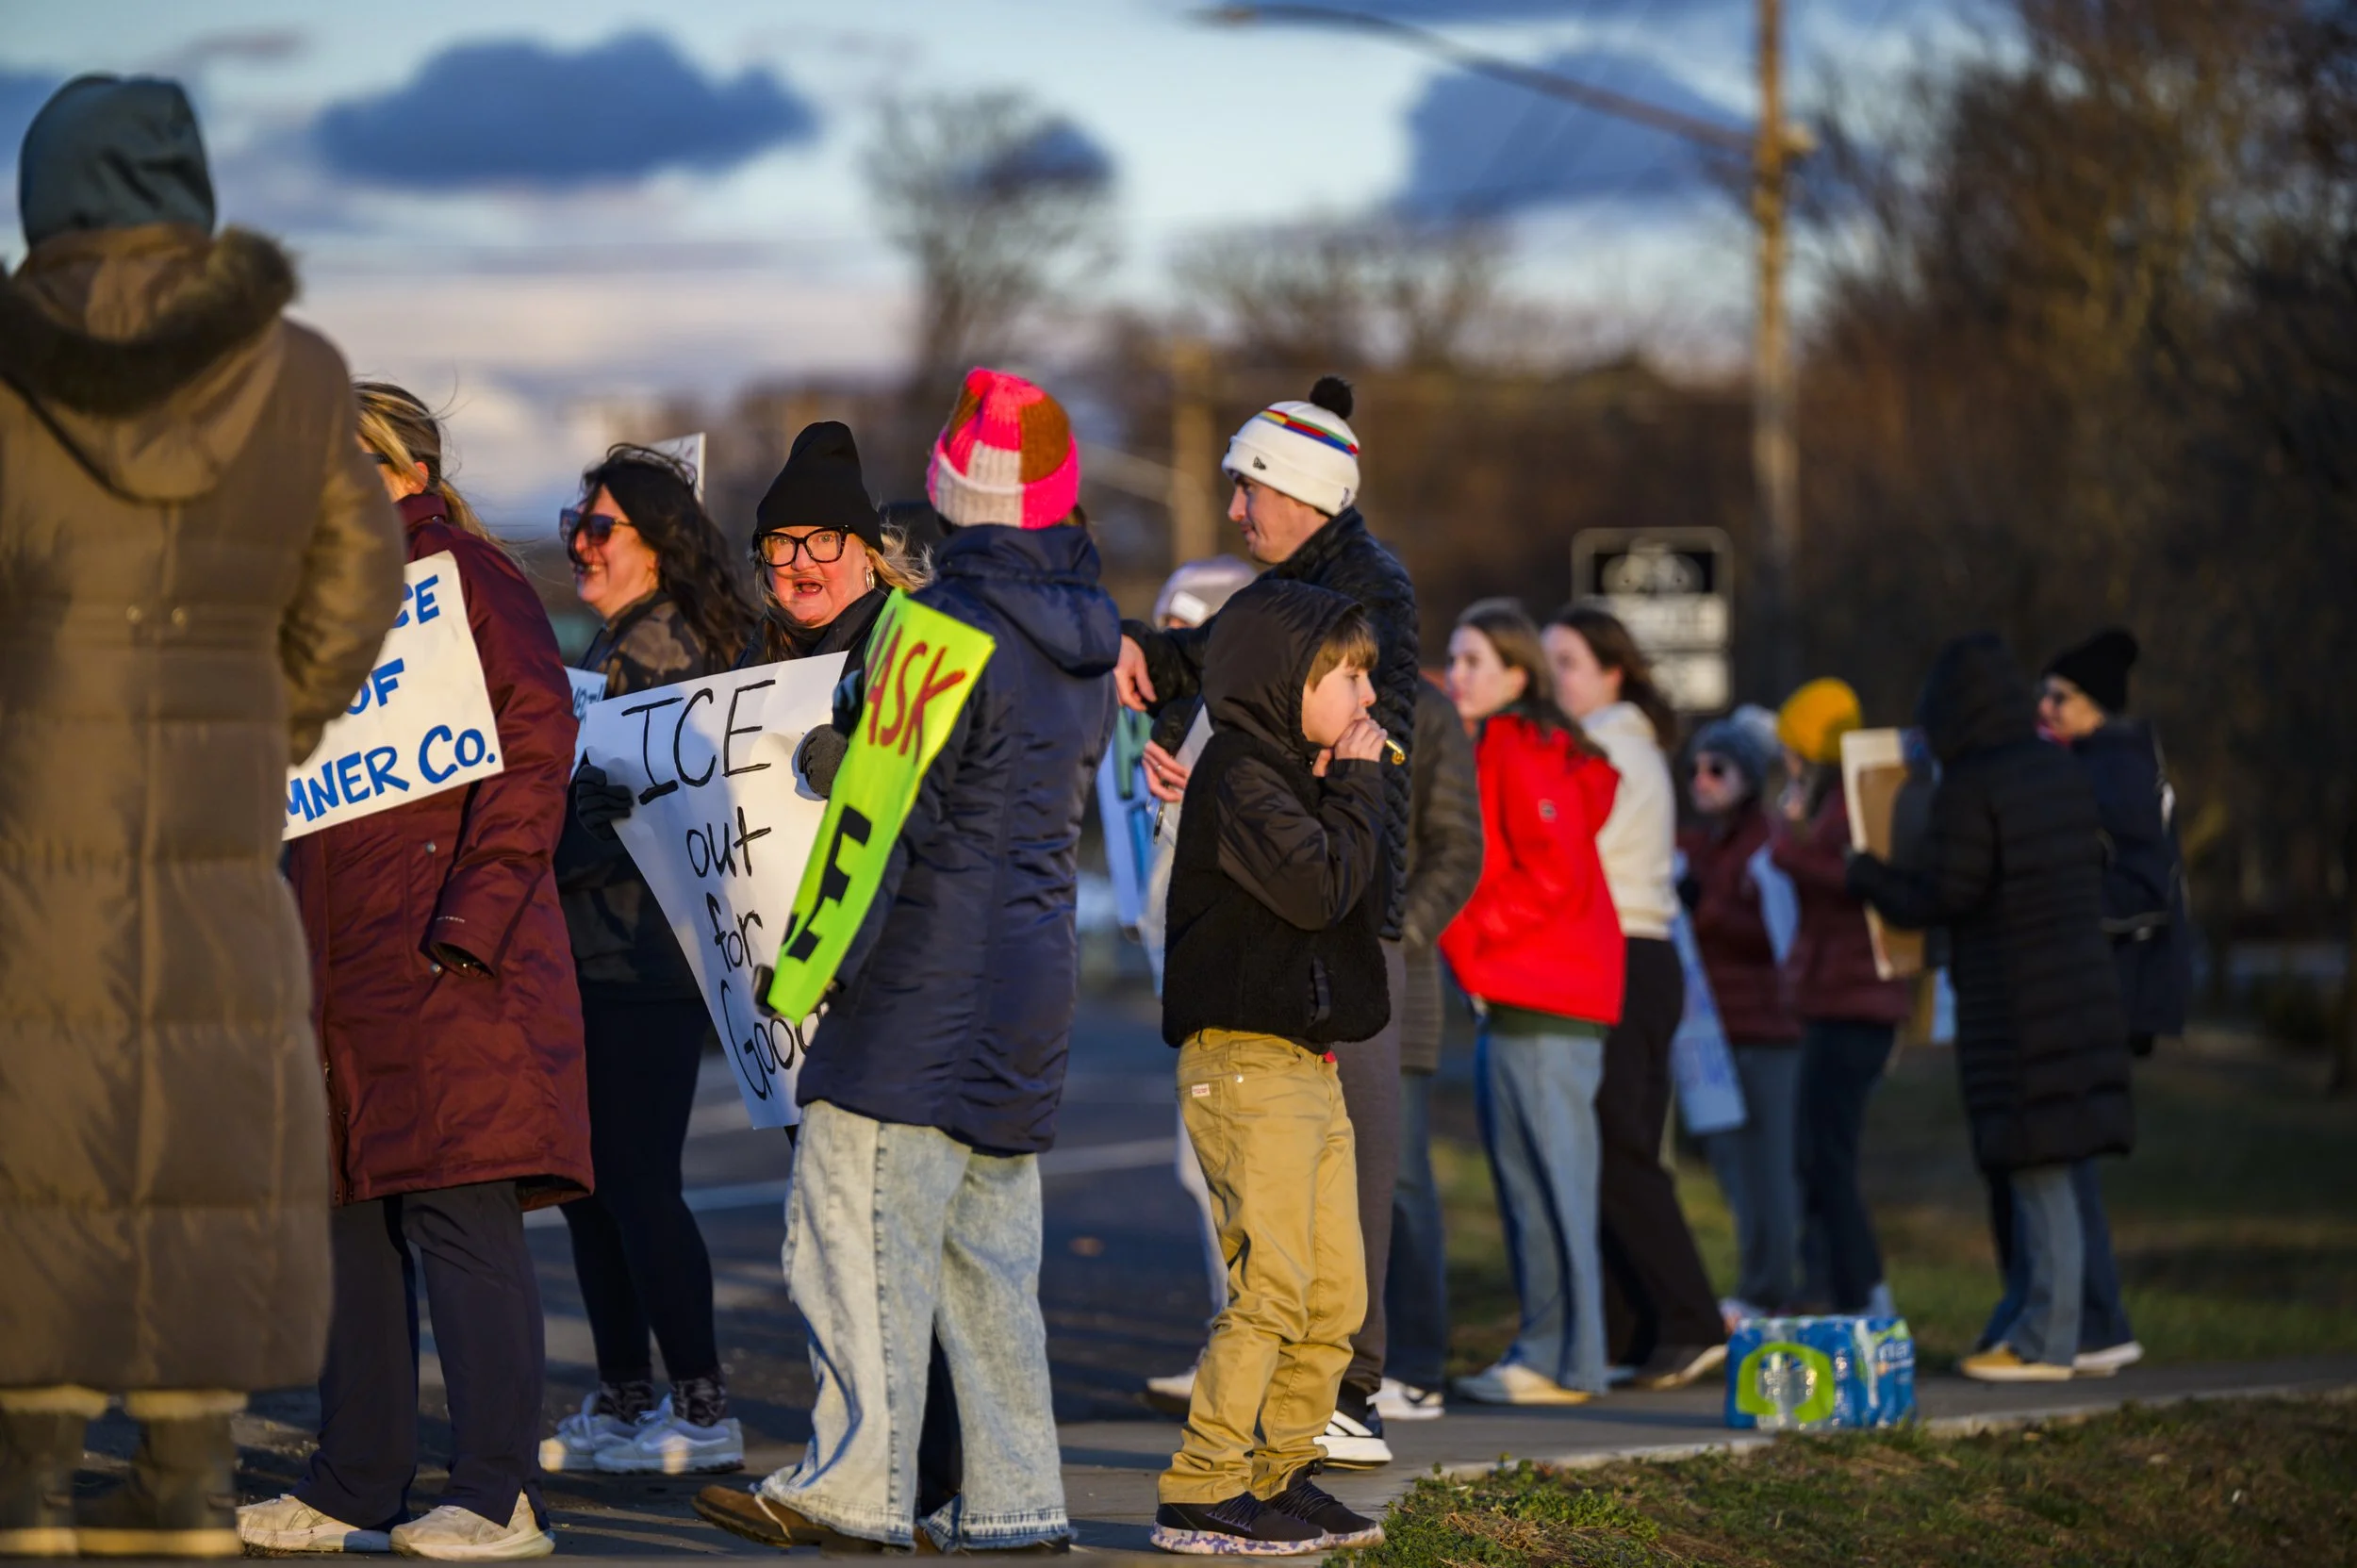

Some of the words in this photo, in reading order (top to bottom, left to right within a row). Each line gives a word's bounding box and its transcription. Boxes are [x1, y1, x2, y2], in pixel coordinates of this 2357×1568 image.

[419, 725, 496, 784] Co.
[621, 679, 776, 805] ICE
[686, 806, 772, 878] out
[706, 892, 763, 973] for
